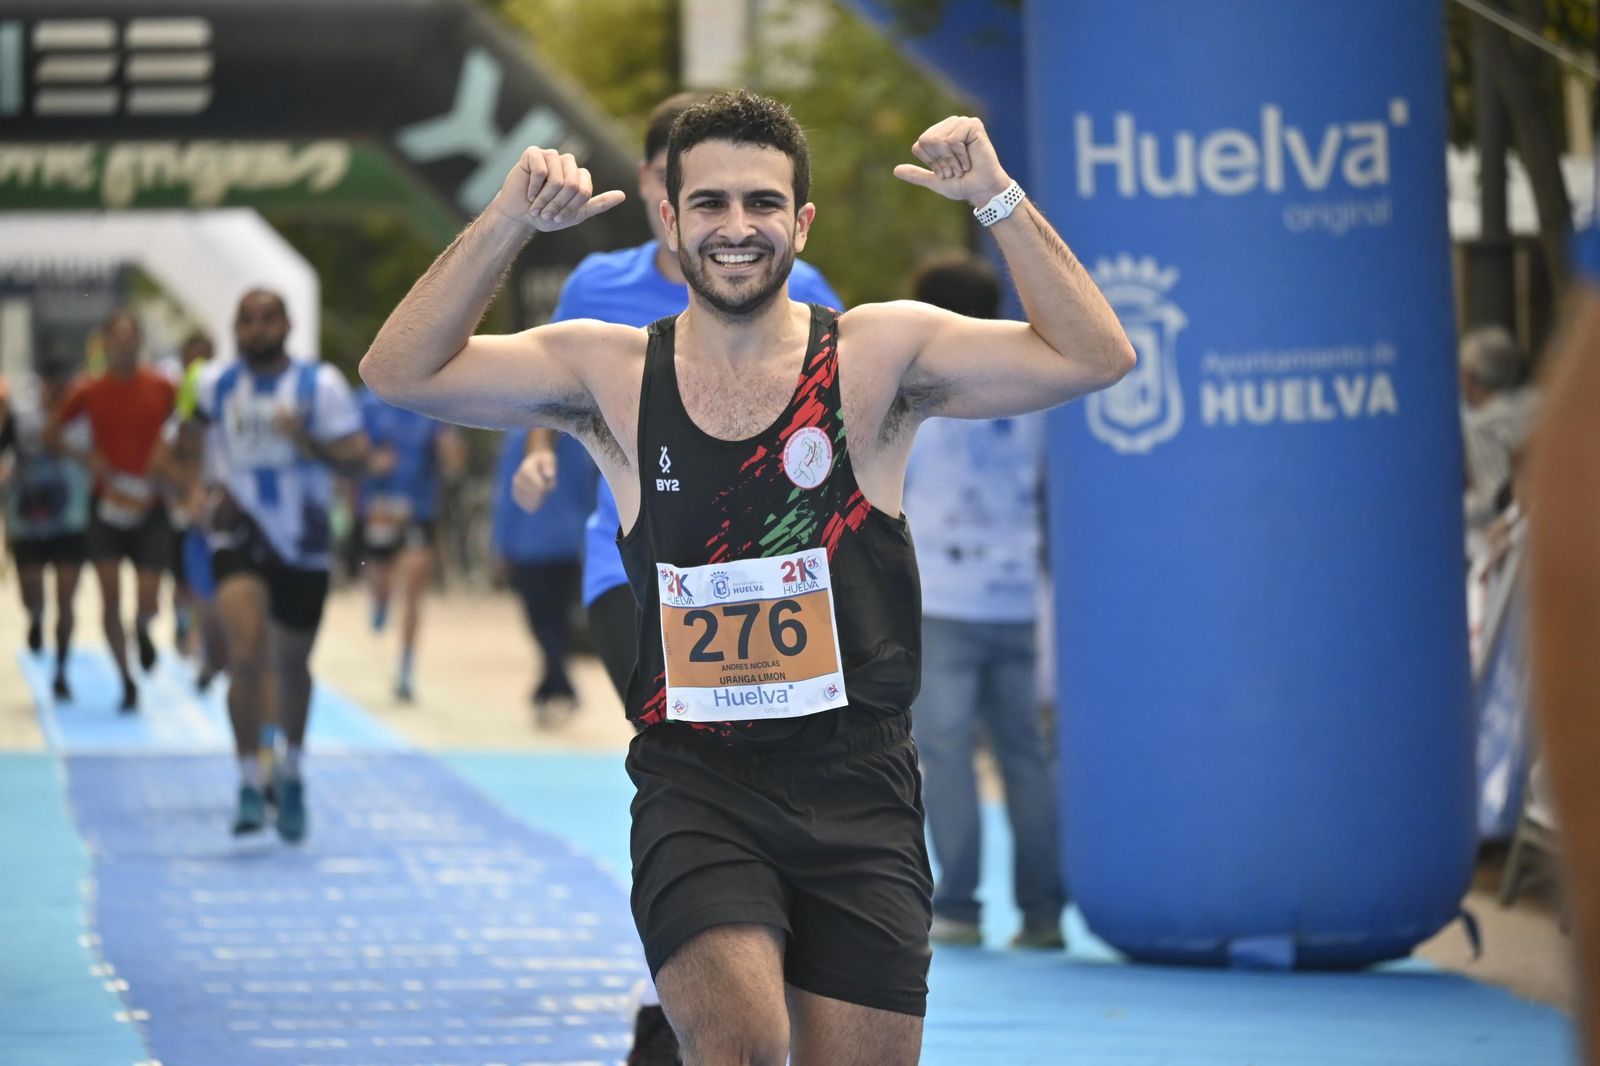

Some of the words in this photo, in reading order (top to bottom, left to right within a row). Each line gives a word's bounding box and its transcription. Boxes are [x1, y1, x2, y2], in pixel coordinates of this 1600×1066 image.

[1075, 102, 1391, 197] Huelva
[1203, 373, 1398, 426] HUELVA
[656, 479, 680, 491] BY2
[733, 585, 764, 594] HUELVA
[783, 580, 819, 595] HUELVA
[683, 600, 807, 662] 276
[721, 663, 748, 672] ANDRES
[750, 660, 780, 670] NICOLAS
[720, 674, 756, 685] URANGA
[759, 672, 786, 681] LIMON
[713, 686, 788, 707] Huelva
